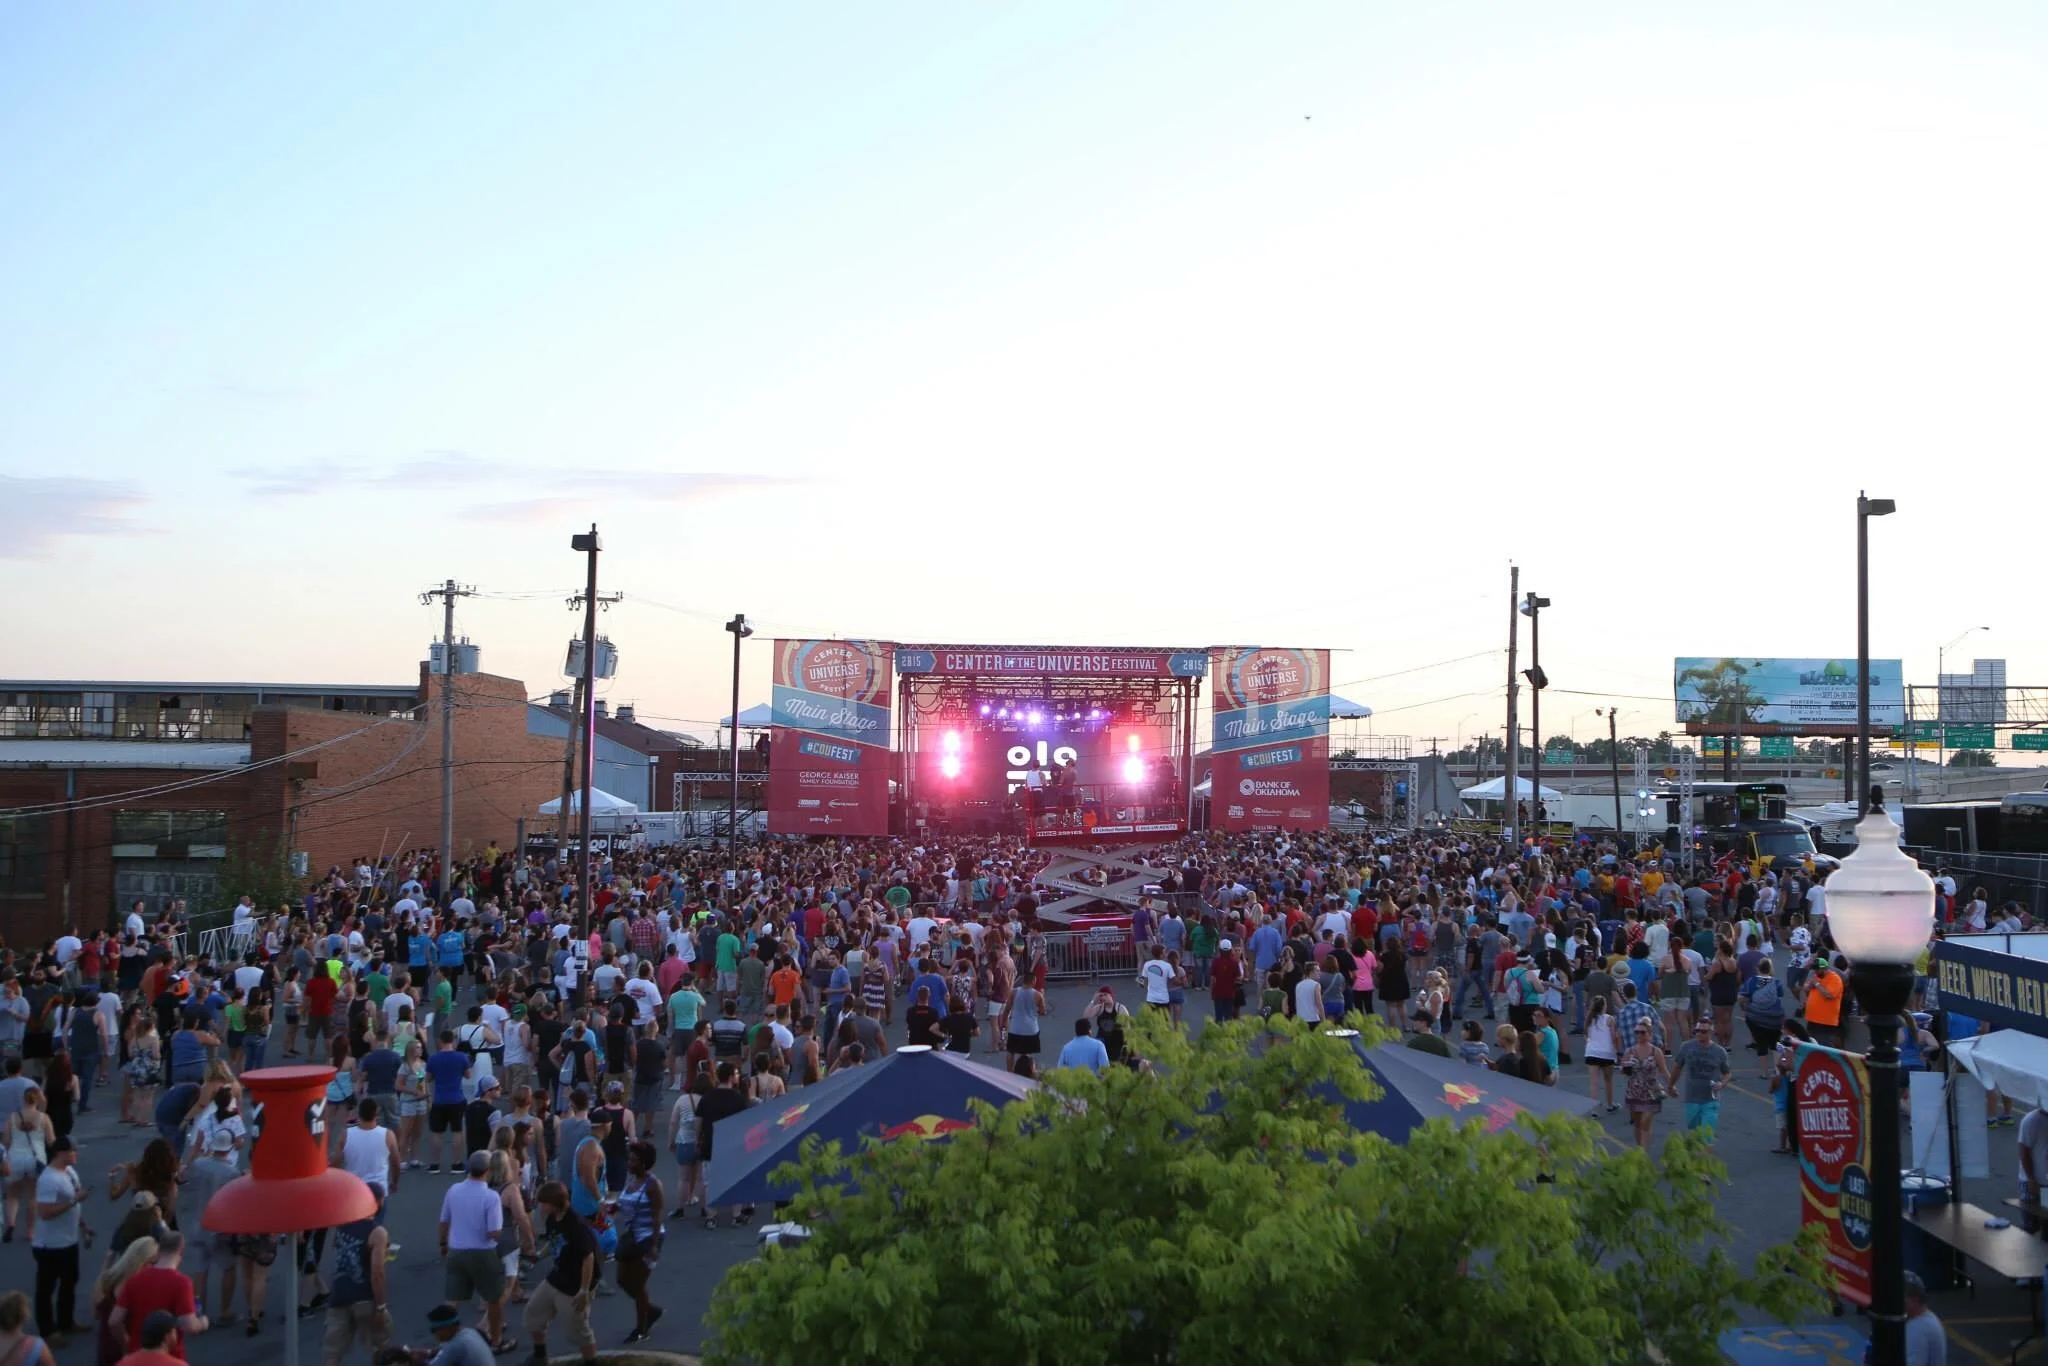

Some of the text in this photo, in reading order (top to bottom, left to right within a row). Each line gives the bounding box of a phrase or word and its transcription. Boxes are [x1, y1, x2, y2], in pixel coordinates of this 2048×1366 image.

[814, 648, 853, 663] CENTER
[946, 654, 1158, 671] CENTER OF THE UNIVERSE FESTIVAL
[1251, 655, 1290, 671] CENTER
[809, 664, 861, 680] UNIVERSE
[1247, 670, 1299, 688] UNIVERSE
[820, 681, 856, 693] FESTIVAL
[1258, 687, 1293, 701] FESTIVAL
[785, 698, 878, 733] Main Stage
[1224, 709, 1318, 738] Main Stage
[800, 771, 859, 780] GEORGE KAISER
[1255, 788, 1300, 797] OKLAHOMA
[1256, 781, 1291, 789] BANK OF
[2016, 976, 2042, 1017] RED
[1803, 1070, 1841, 1097] CENTER
[1801, 1106, 1851, 1131] UNIVERSE
[1841, 1191, 1872, 1221] WEEKEN
